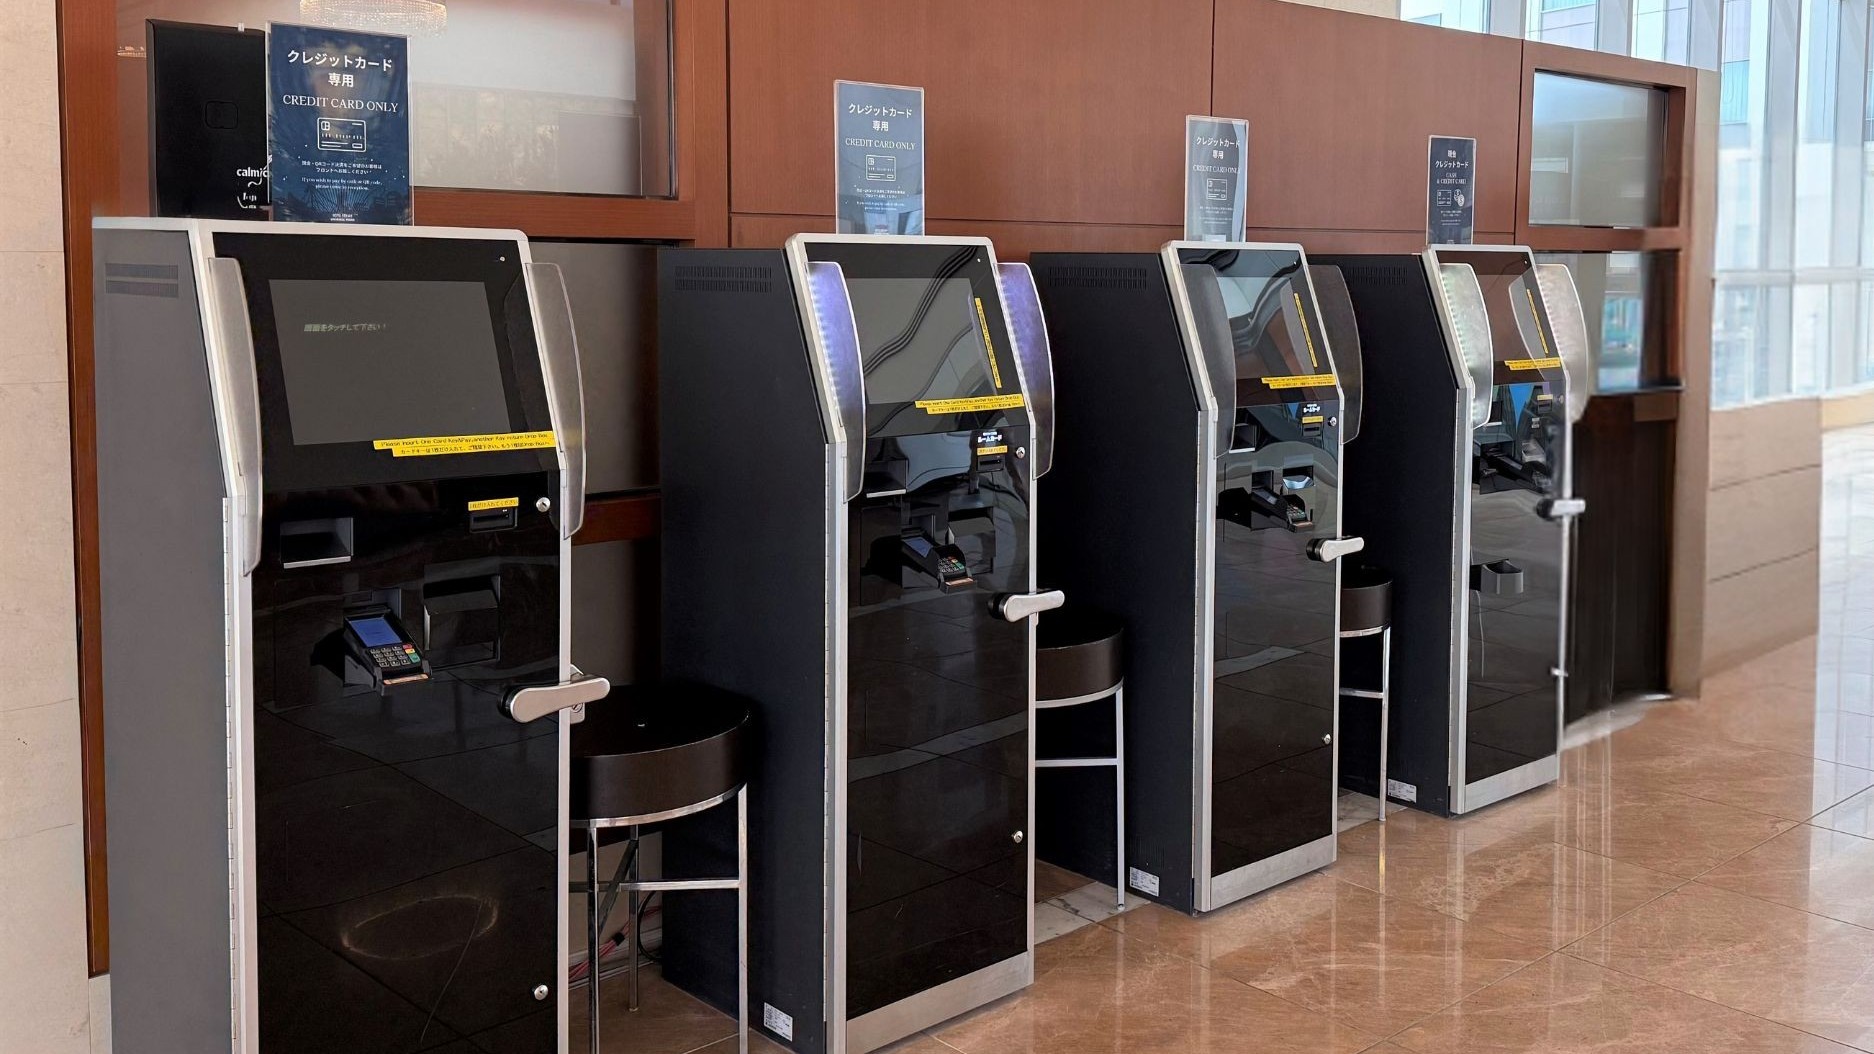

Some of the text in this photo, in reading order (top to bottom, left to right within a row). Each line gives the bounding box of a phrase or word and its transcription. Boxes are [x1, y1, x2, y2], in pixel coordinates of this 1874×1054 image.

[287, 50, 393, 72] クレジットカード
[327, 72, 354, 88] 専用
[282, 94, 399, 113] CREDIT CARD ONLY
[848, 102, 913, 119] クレジットカード
[872, 120, 889, 132] 専用
[845, 137, 916, 150] CREDIT CARD ONLY
